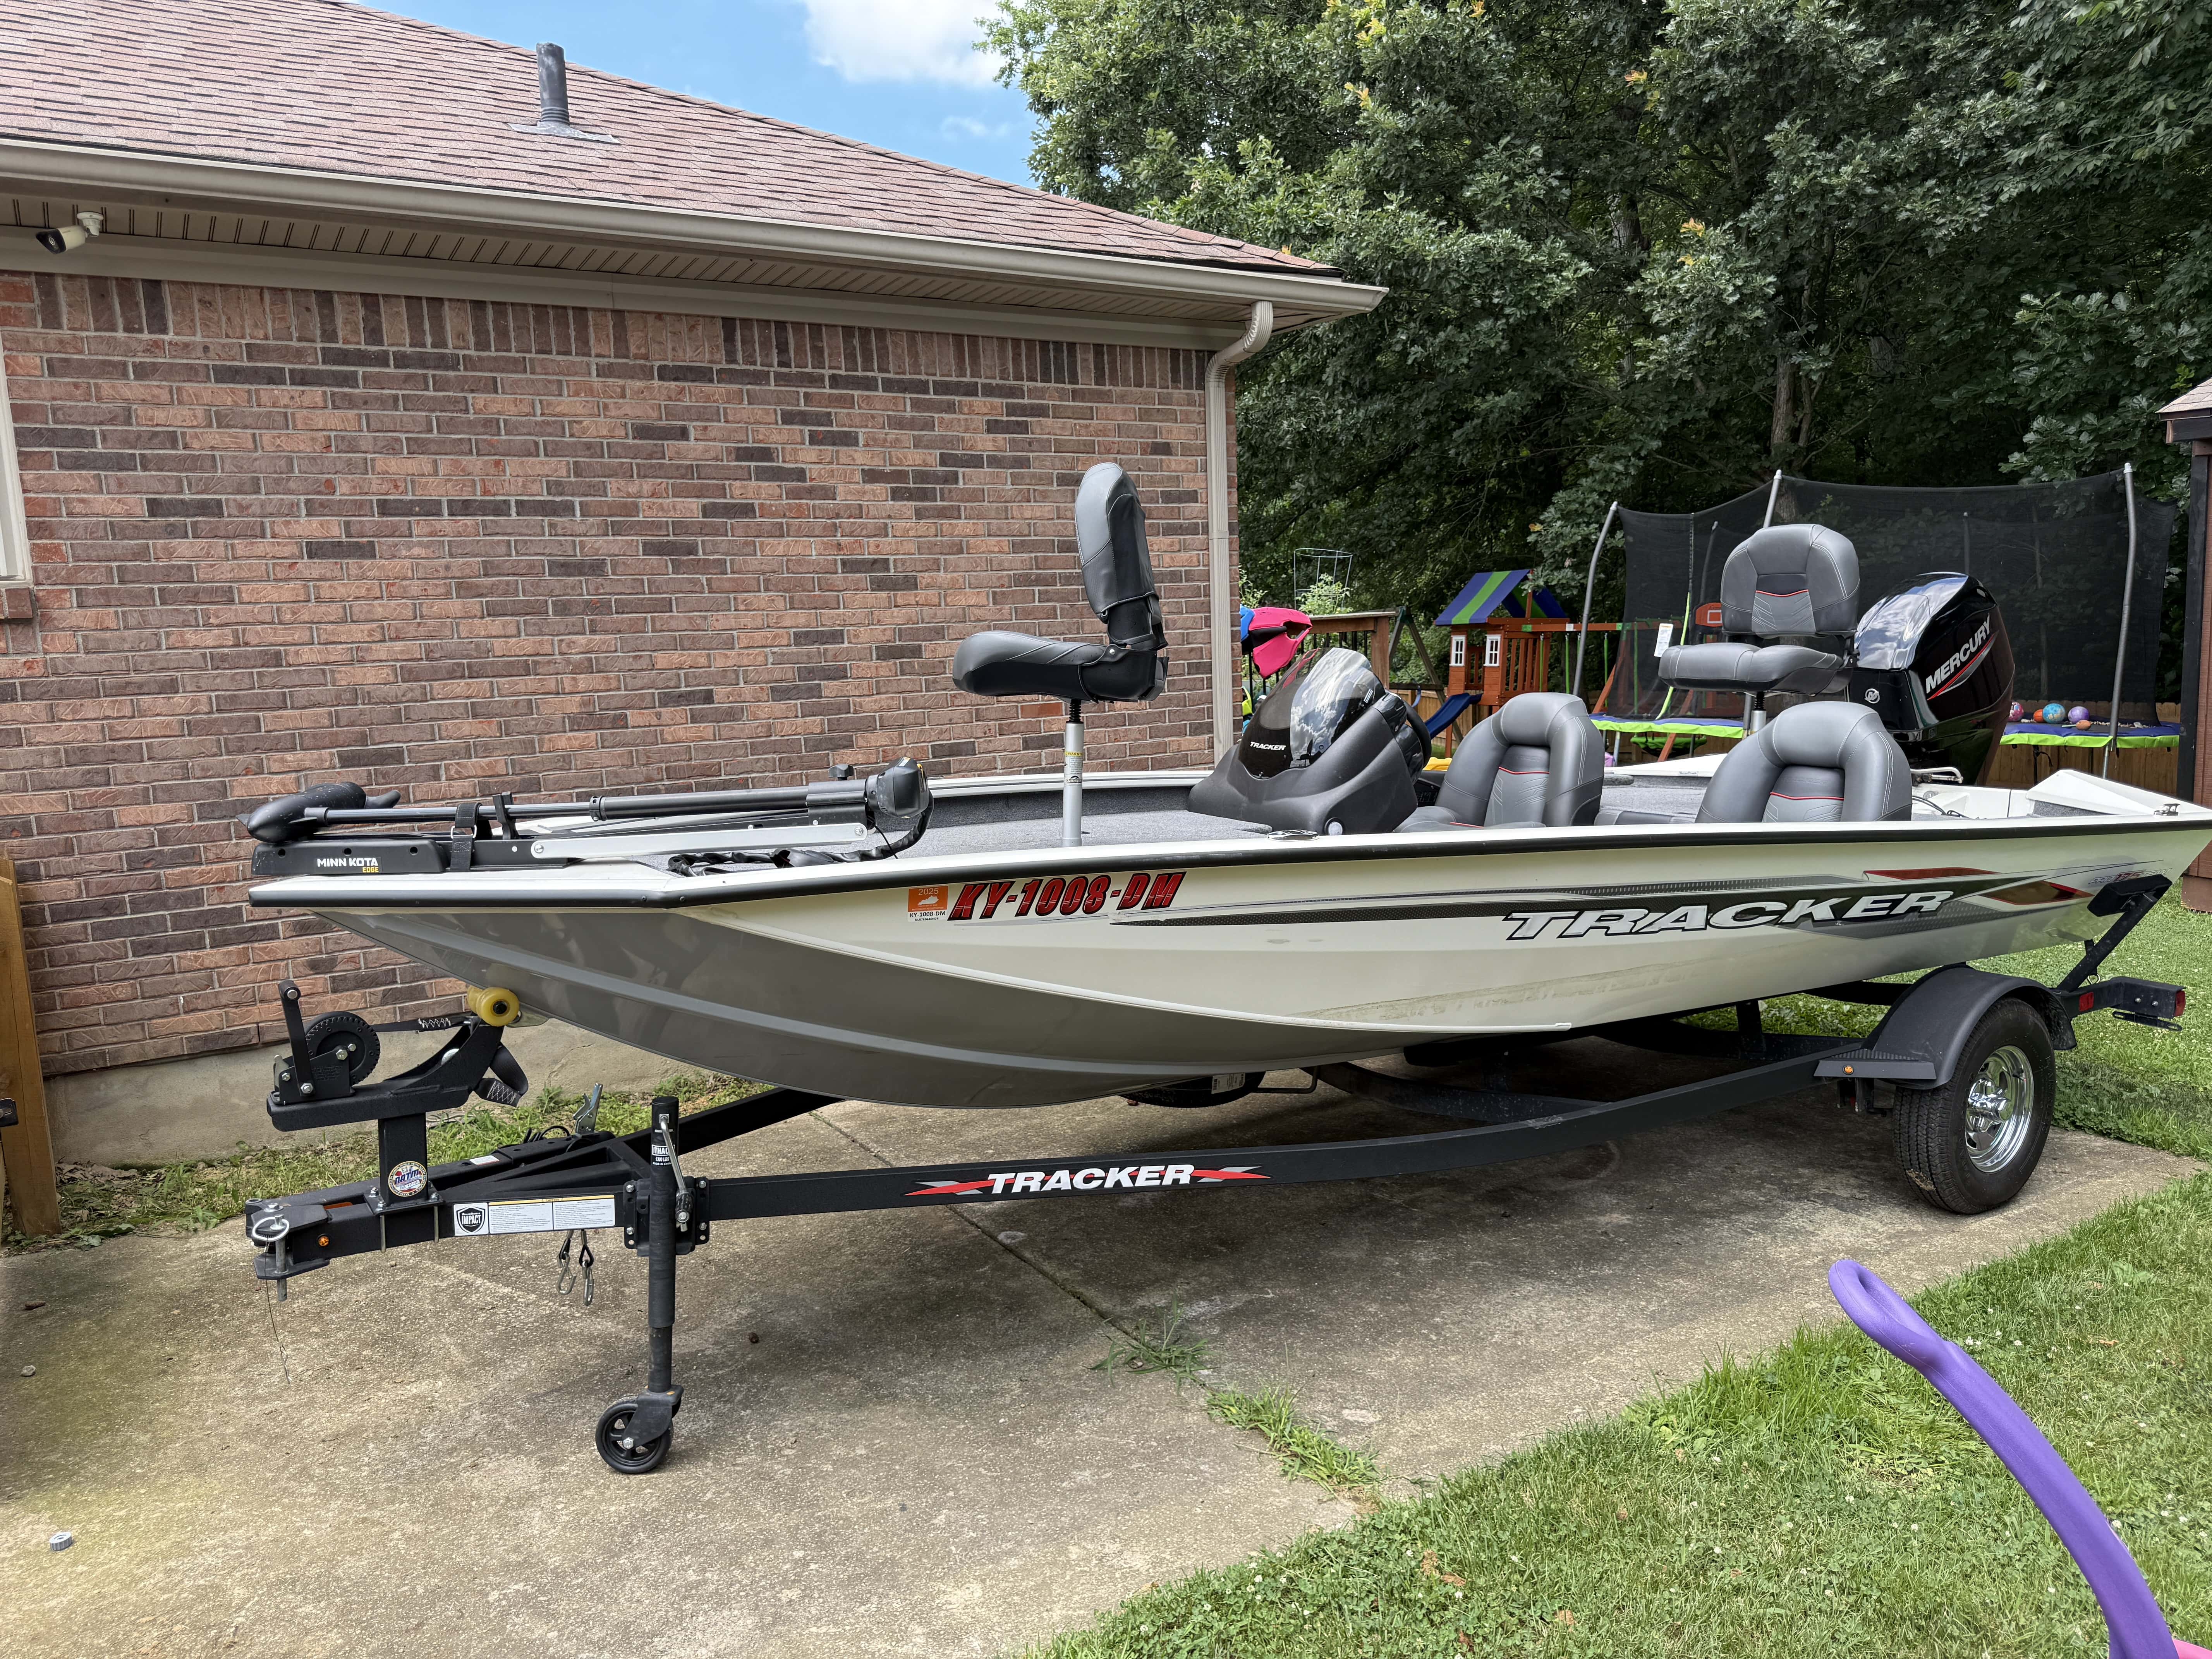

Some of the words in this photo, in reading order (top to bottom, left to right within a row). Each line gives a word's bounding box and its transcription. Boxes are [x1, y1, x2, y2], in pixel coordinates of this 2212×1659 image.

[1925, 613, 1992, 694] MERCURY
[1250, 741, 1286, 750] TRACKER
[317, 858, 347, 867] MINN
[349, 857, 379, 867] KOTA
[2088, 875, 2116, 884] PRO
[2113, 869, 2146, 882] 175
[947, 871, 1187, 921] KY-1008-DM
[1505, 890, 1954, 941] TRACKER
[987, 1164, 1195, 1194] TRACKER
[461, 1214, 481, 1225] IMPACT
